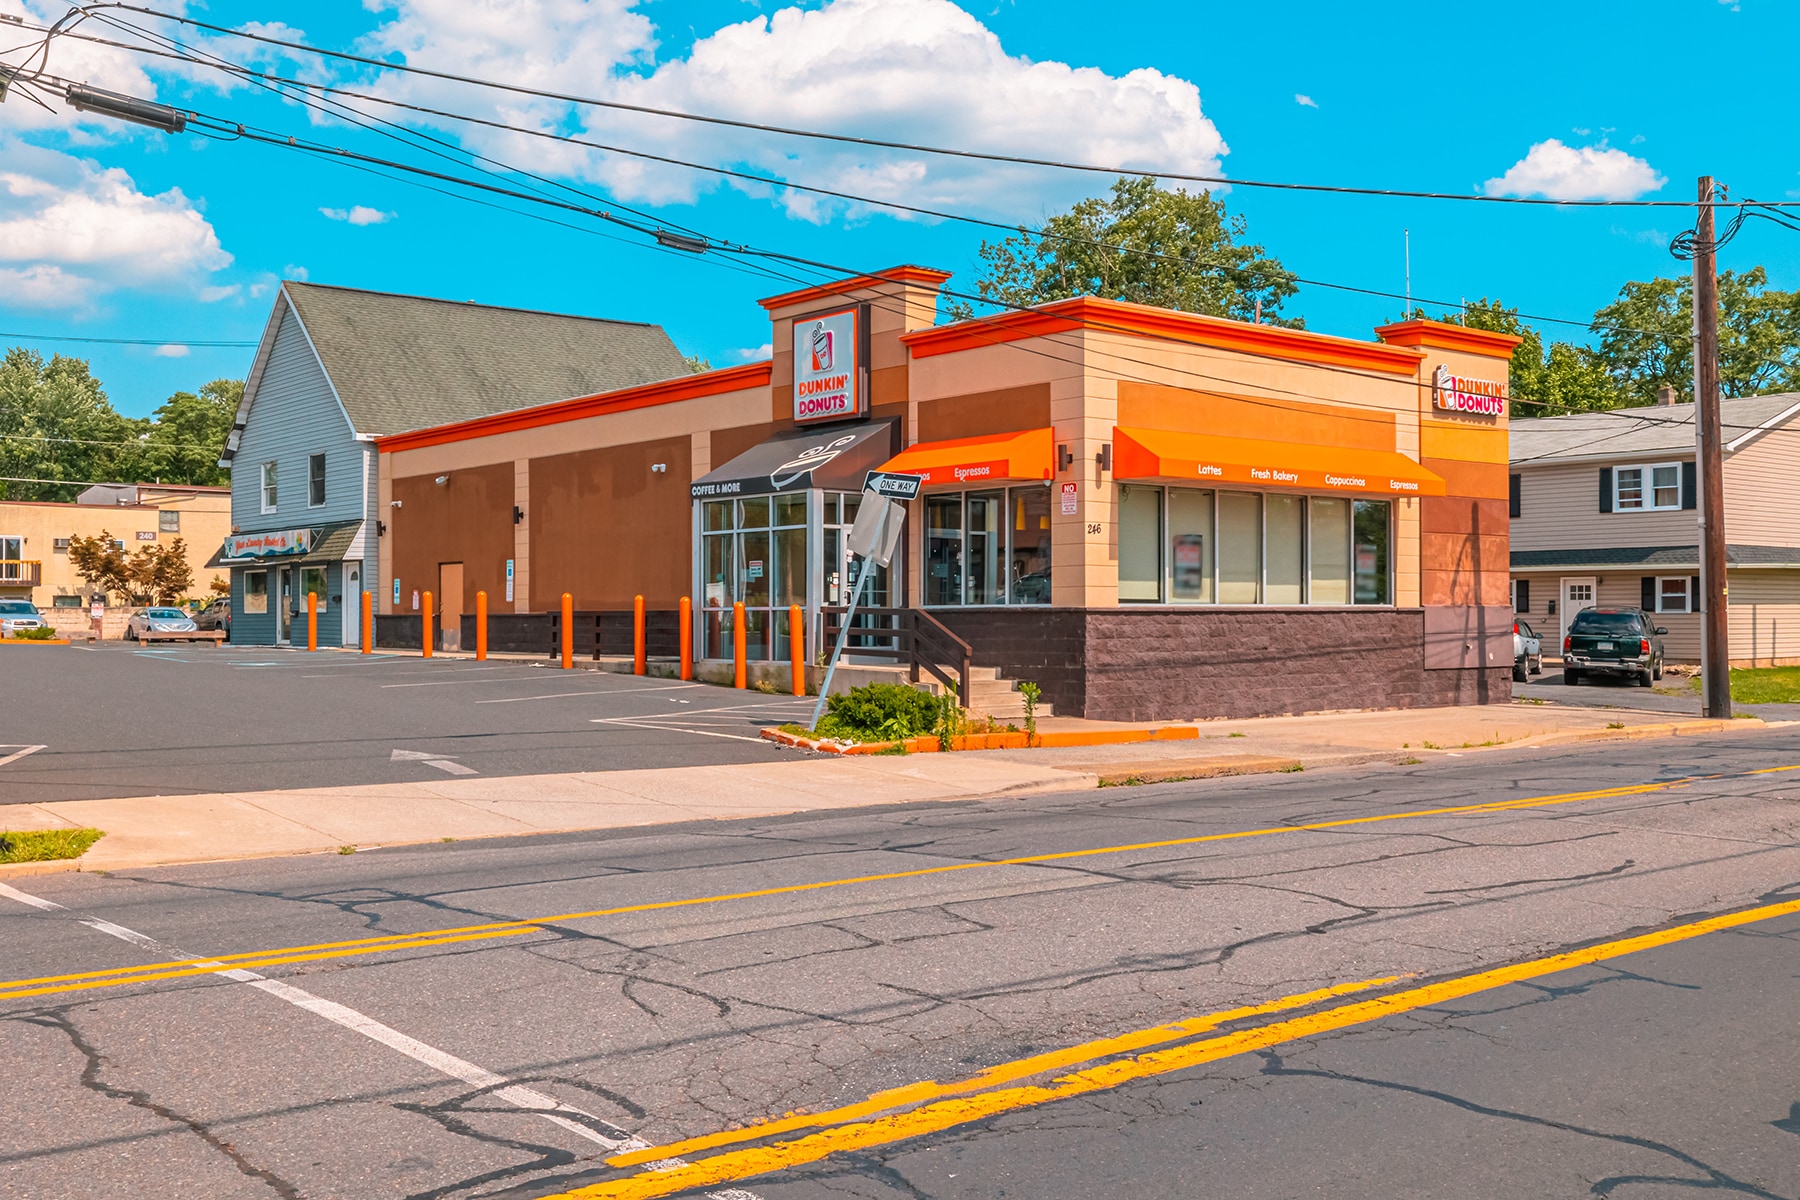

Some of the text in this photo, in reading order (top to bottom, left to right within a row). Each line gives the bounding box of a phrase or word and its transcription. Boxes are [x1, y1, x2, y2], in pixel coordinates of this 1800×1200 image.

[799, 374, 848, 396] DUNKIN'
[1457, 377, 1505, 398] DUNKIN'
[799, 394, 846, 415] DONUTS
[1457, 393, 1503, 414] DONUTS
[954, 466, 990, 481] Espressos
[1198, 464, 1222, 476] Lattes
[1251, 468, 1298, 484] Fresh Bakery
[880, 479, 914, 491] ONE WAY
[1325, 474, 1366, 487] Cappuccinos
[1390, 480, 1418, 491] Espressos
[691, 482, 741, 496] COFFEE & MORE
[1064, 484, 1075, 493] NO
[1087, 523, 1102, 535] 246
[139, 532, 154, 540] 240
